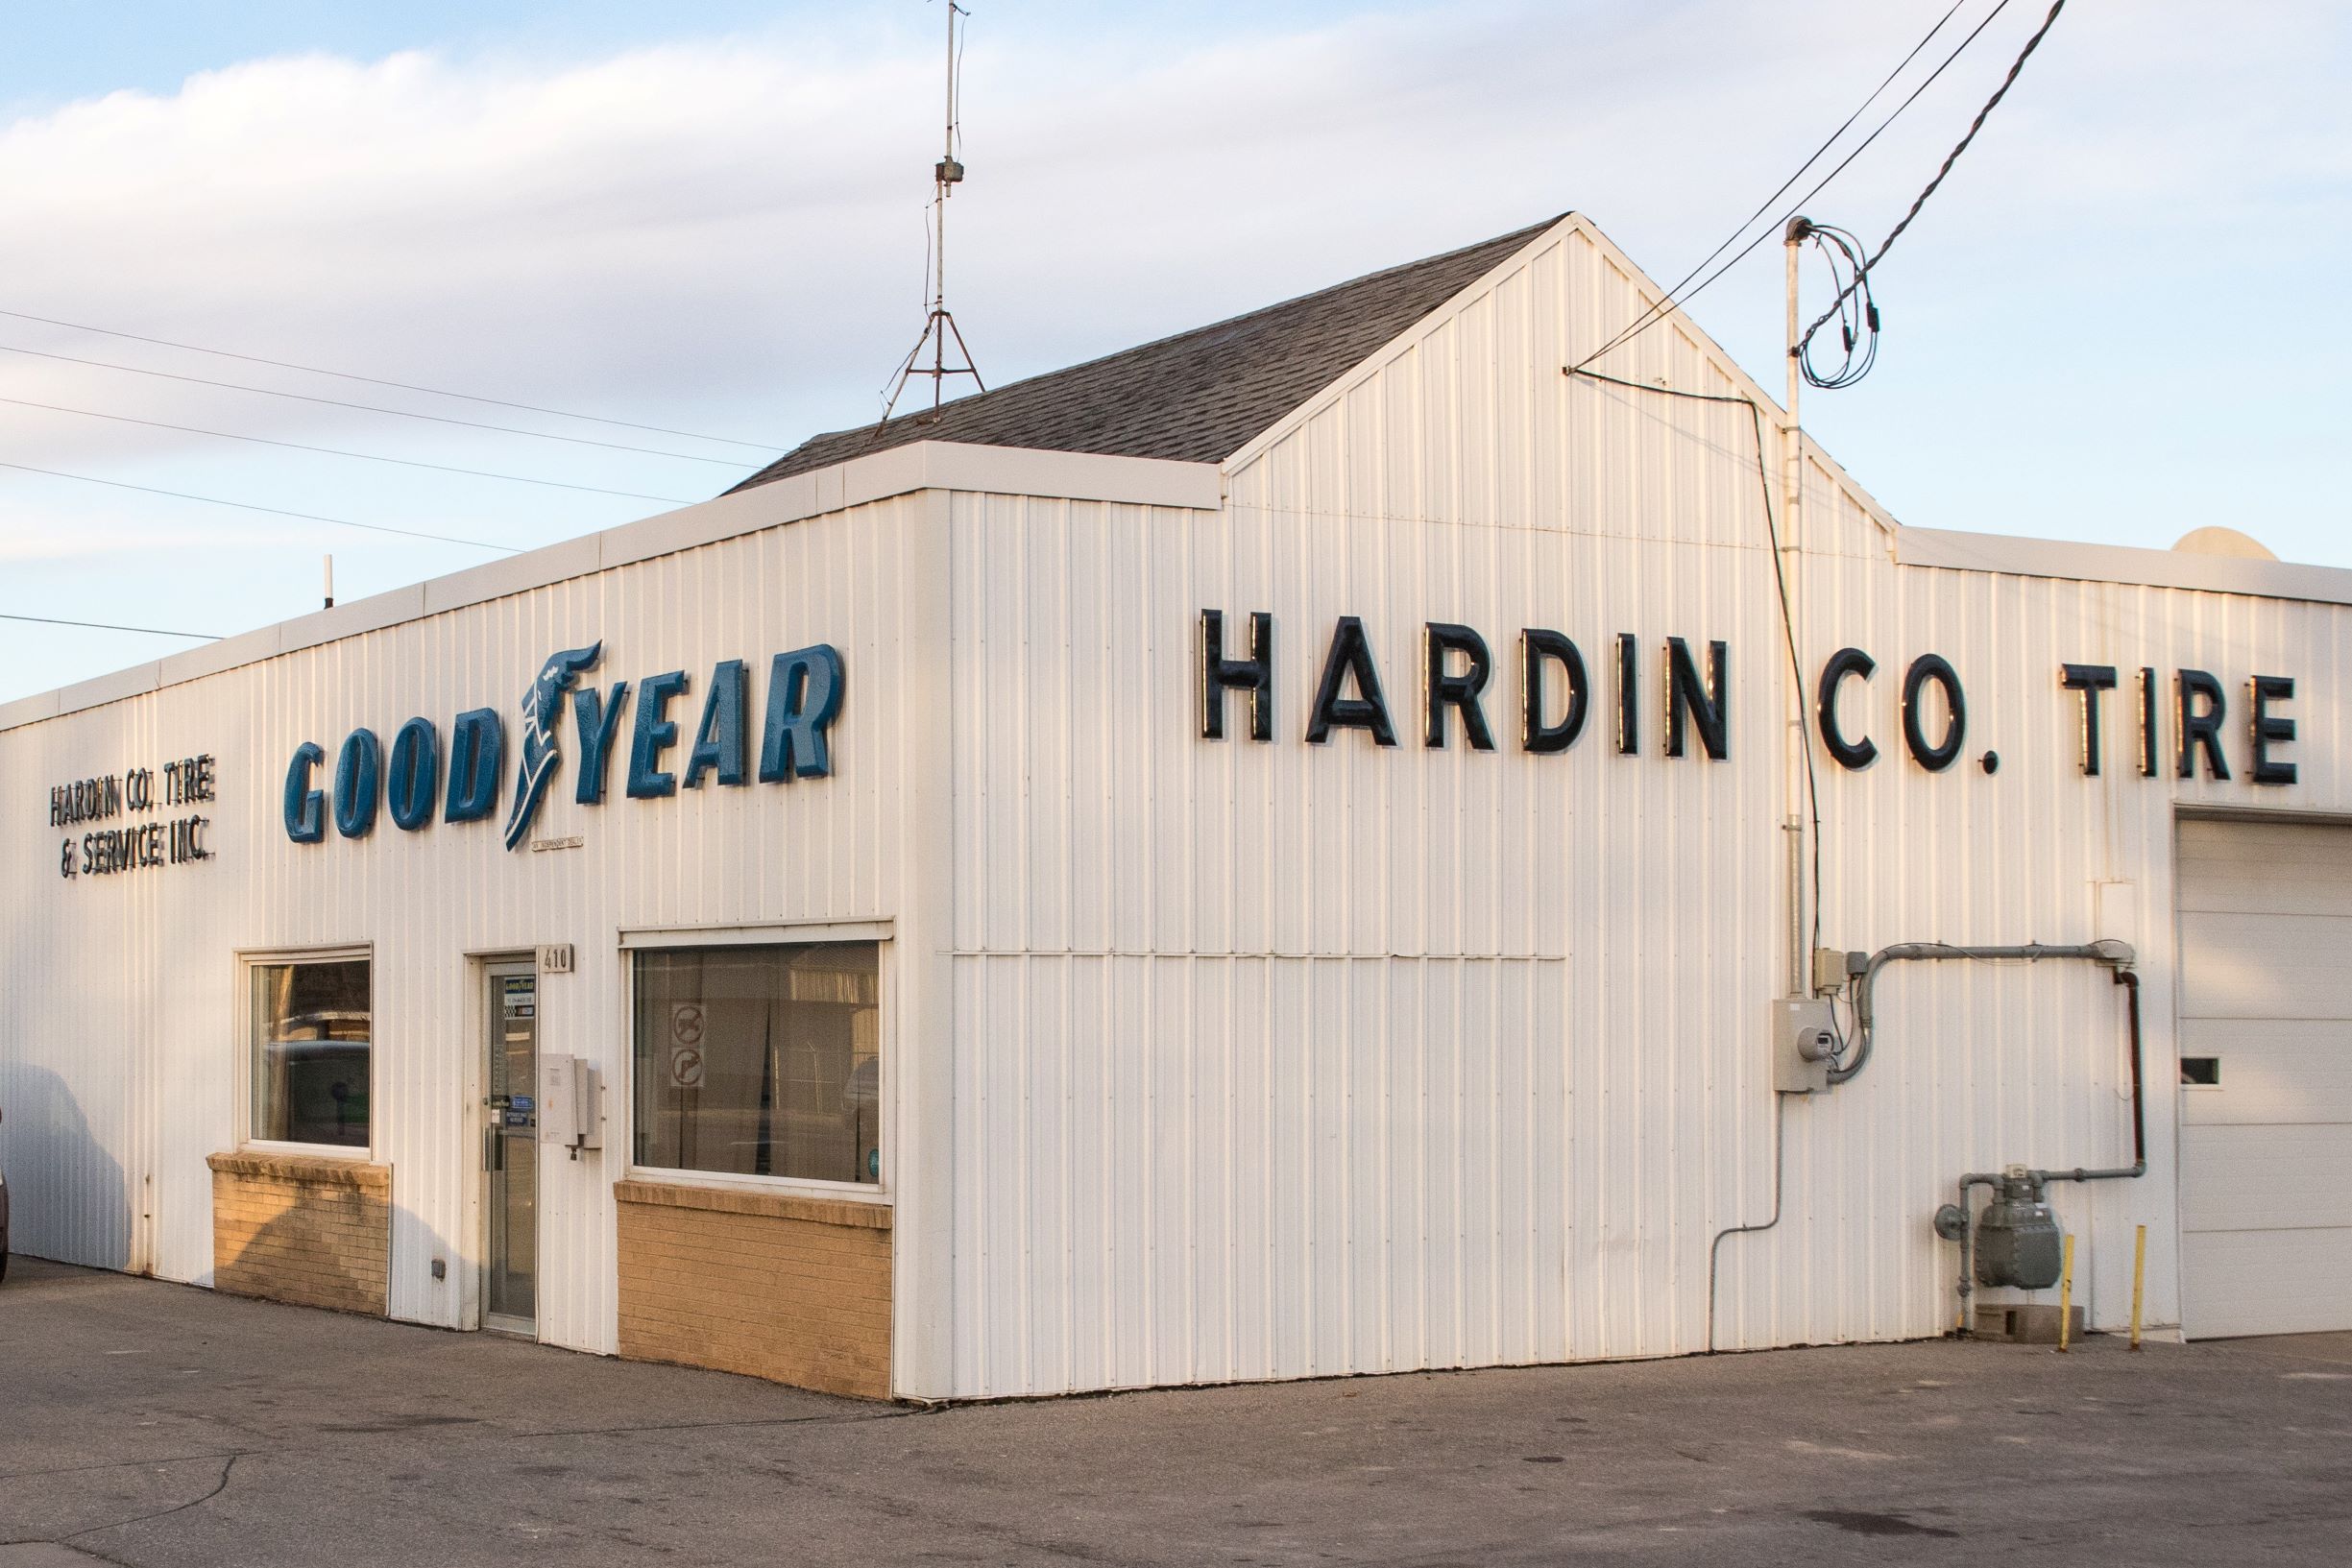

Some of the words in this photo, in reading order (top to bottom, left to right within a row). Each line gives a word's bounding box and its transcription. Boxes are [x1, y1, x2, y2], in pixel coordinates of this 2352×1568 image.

[1200, 608, 1728, 760] HARDIN
[1817, 646, 1999, 775] CO.
[2060, 663, 2298, 784] TIRE
[283, 642, 844, 843] GOODYEAR
[50, 774, 114, 827] HARDIN
[163, 754, 209, 806] TIRE
[61, 837, 72, 879] &
[83, 822, 161, 875] SERVICE
[545, 949, 567, 969] 410
